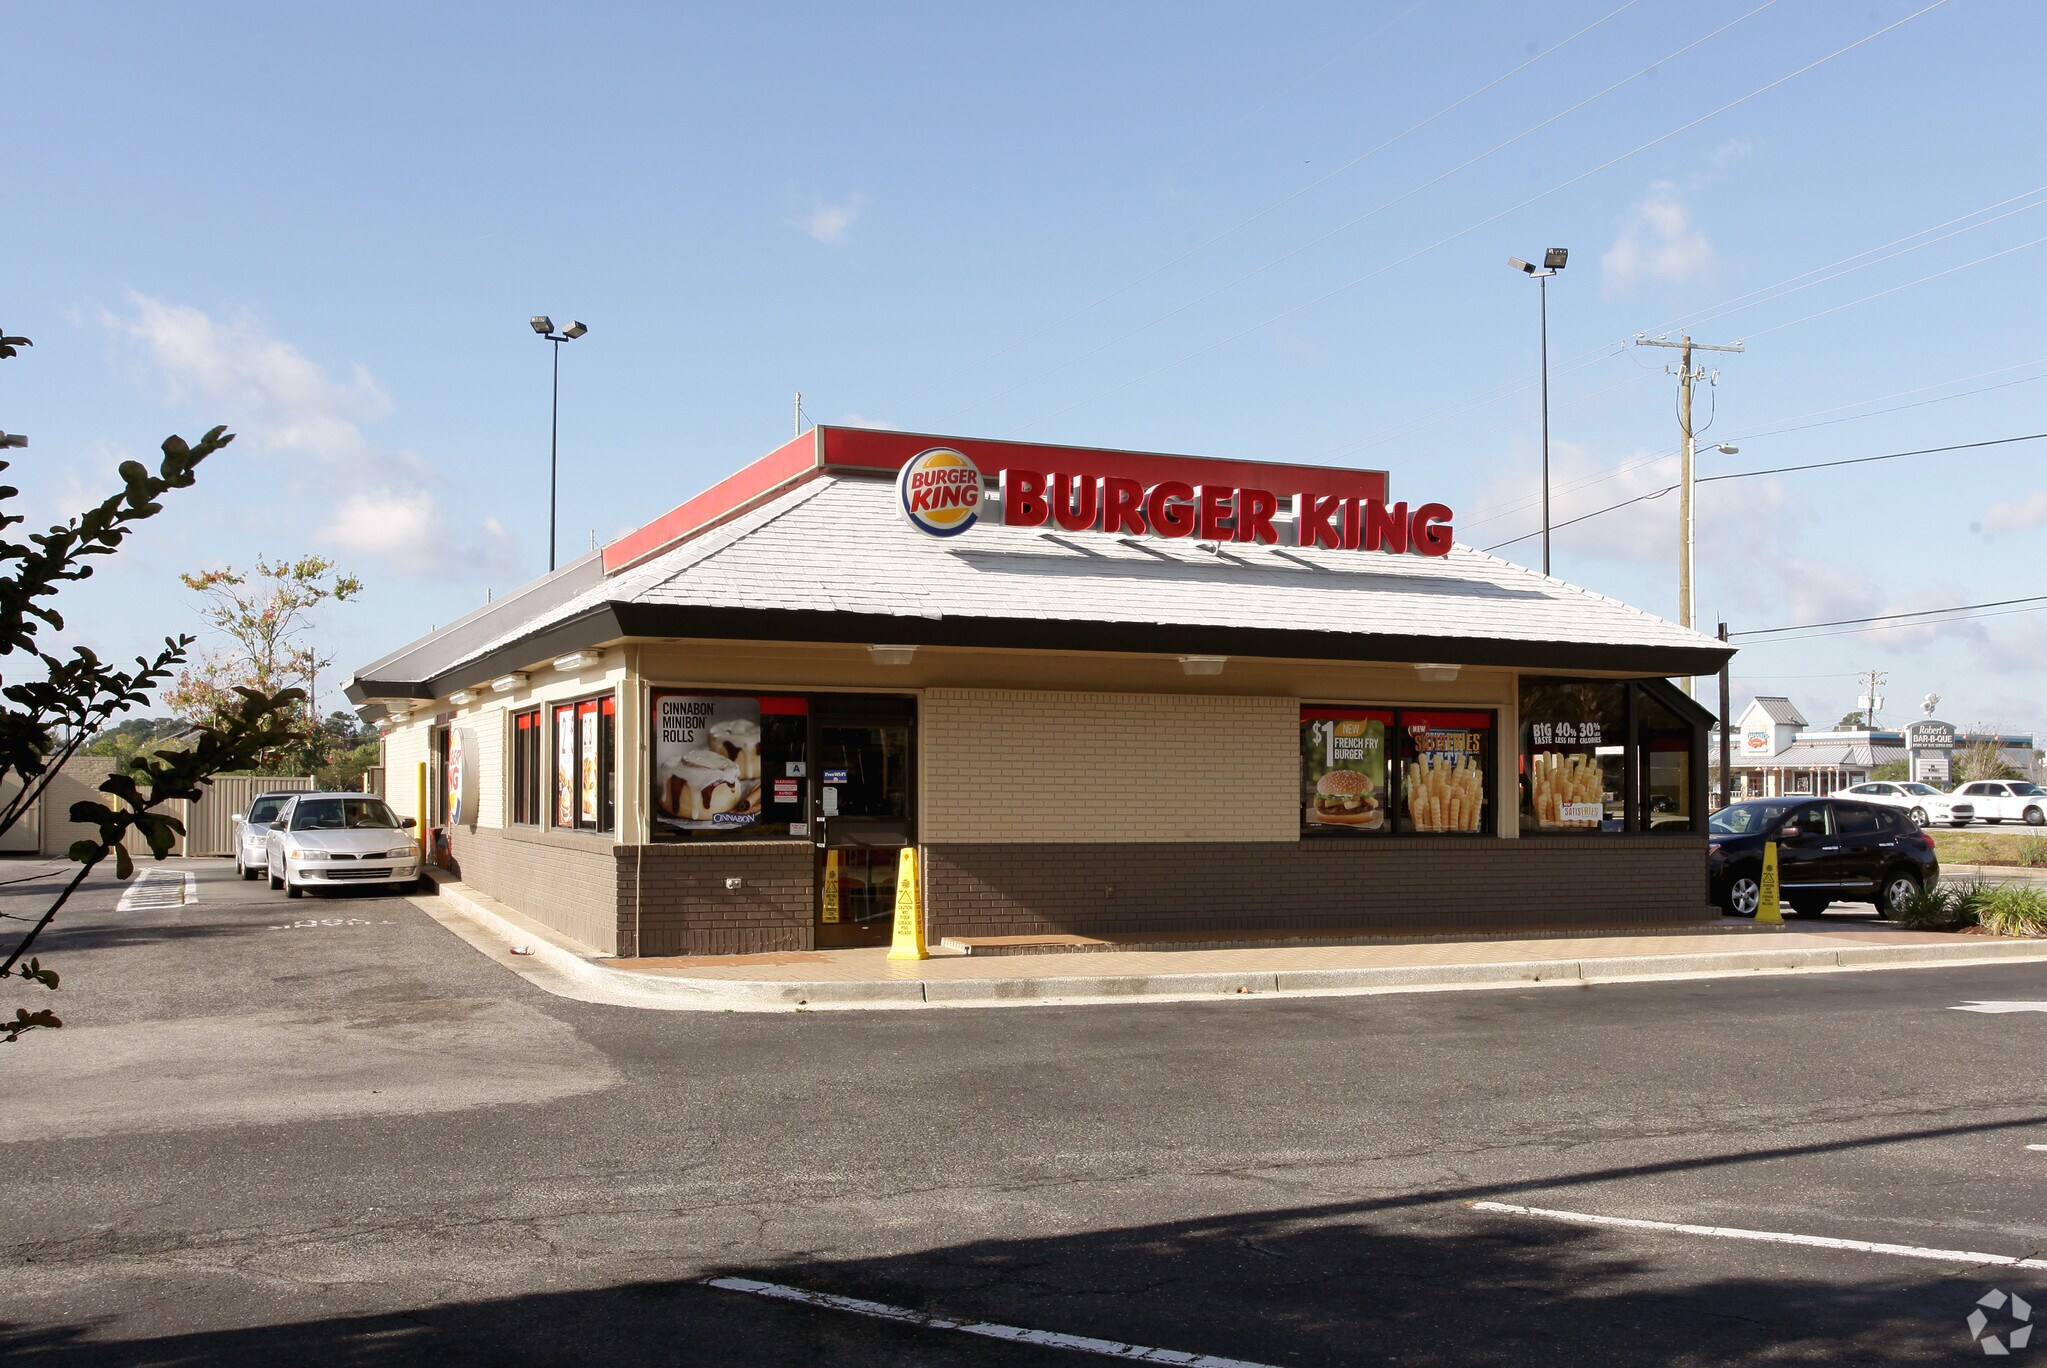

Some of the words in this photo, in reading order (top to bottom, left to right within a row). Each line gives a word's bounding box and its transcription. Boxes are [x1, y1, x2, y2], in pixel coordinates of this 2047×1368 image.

[911, 468, 978, 490] BURGER
[910, 485, 979, 513] KING
[1001, 468, 1279, 546] BURGER
[1298, 491, 1455, 558] KING
[662, 701, 714, 716] CINNABON
[662, 715, 706, 730] MINIBON
[1342, 723, 1360, 735] NEW
[1412, 725, 1426, 733] NEW
[1532, 722, 1552, 737] BIG
[1555, 721, 1577, 737] 40%
[1919, 725, 1947, 734] Robert's
[662, 729, 694, 743] ROLLS
[1534, 736, 1552, 745] TASTE
[1555, 736, 1567, 744] LESS
[1567, 736, 1577, 744] FAT
[1579, 736, 1602, 744] CALORIES
[1913, 734, 1952, 743] BAR-B-QUE
[1312, 720, 1334, 767] $1
[1334, 737, 1364, 749] FRENCH
[1364, 738, 1379, 749] FRY
[1334, 748, 1364, 760] BURGER
[792, 764, 801, 773] A
[713, 813, 755, 823] CINNABON
